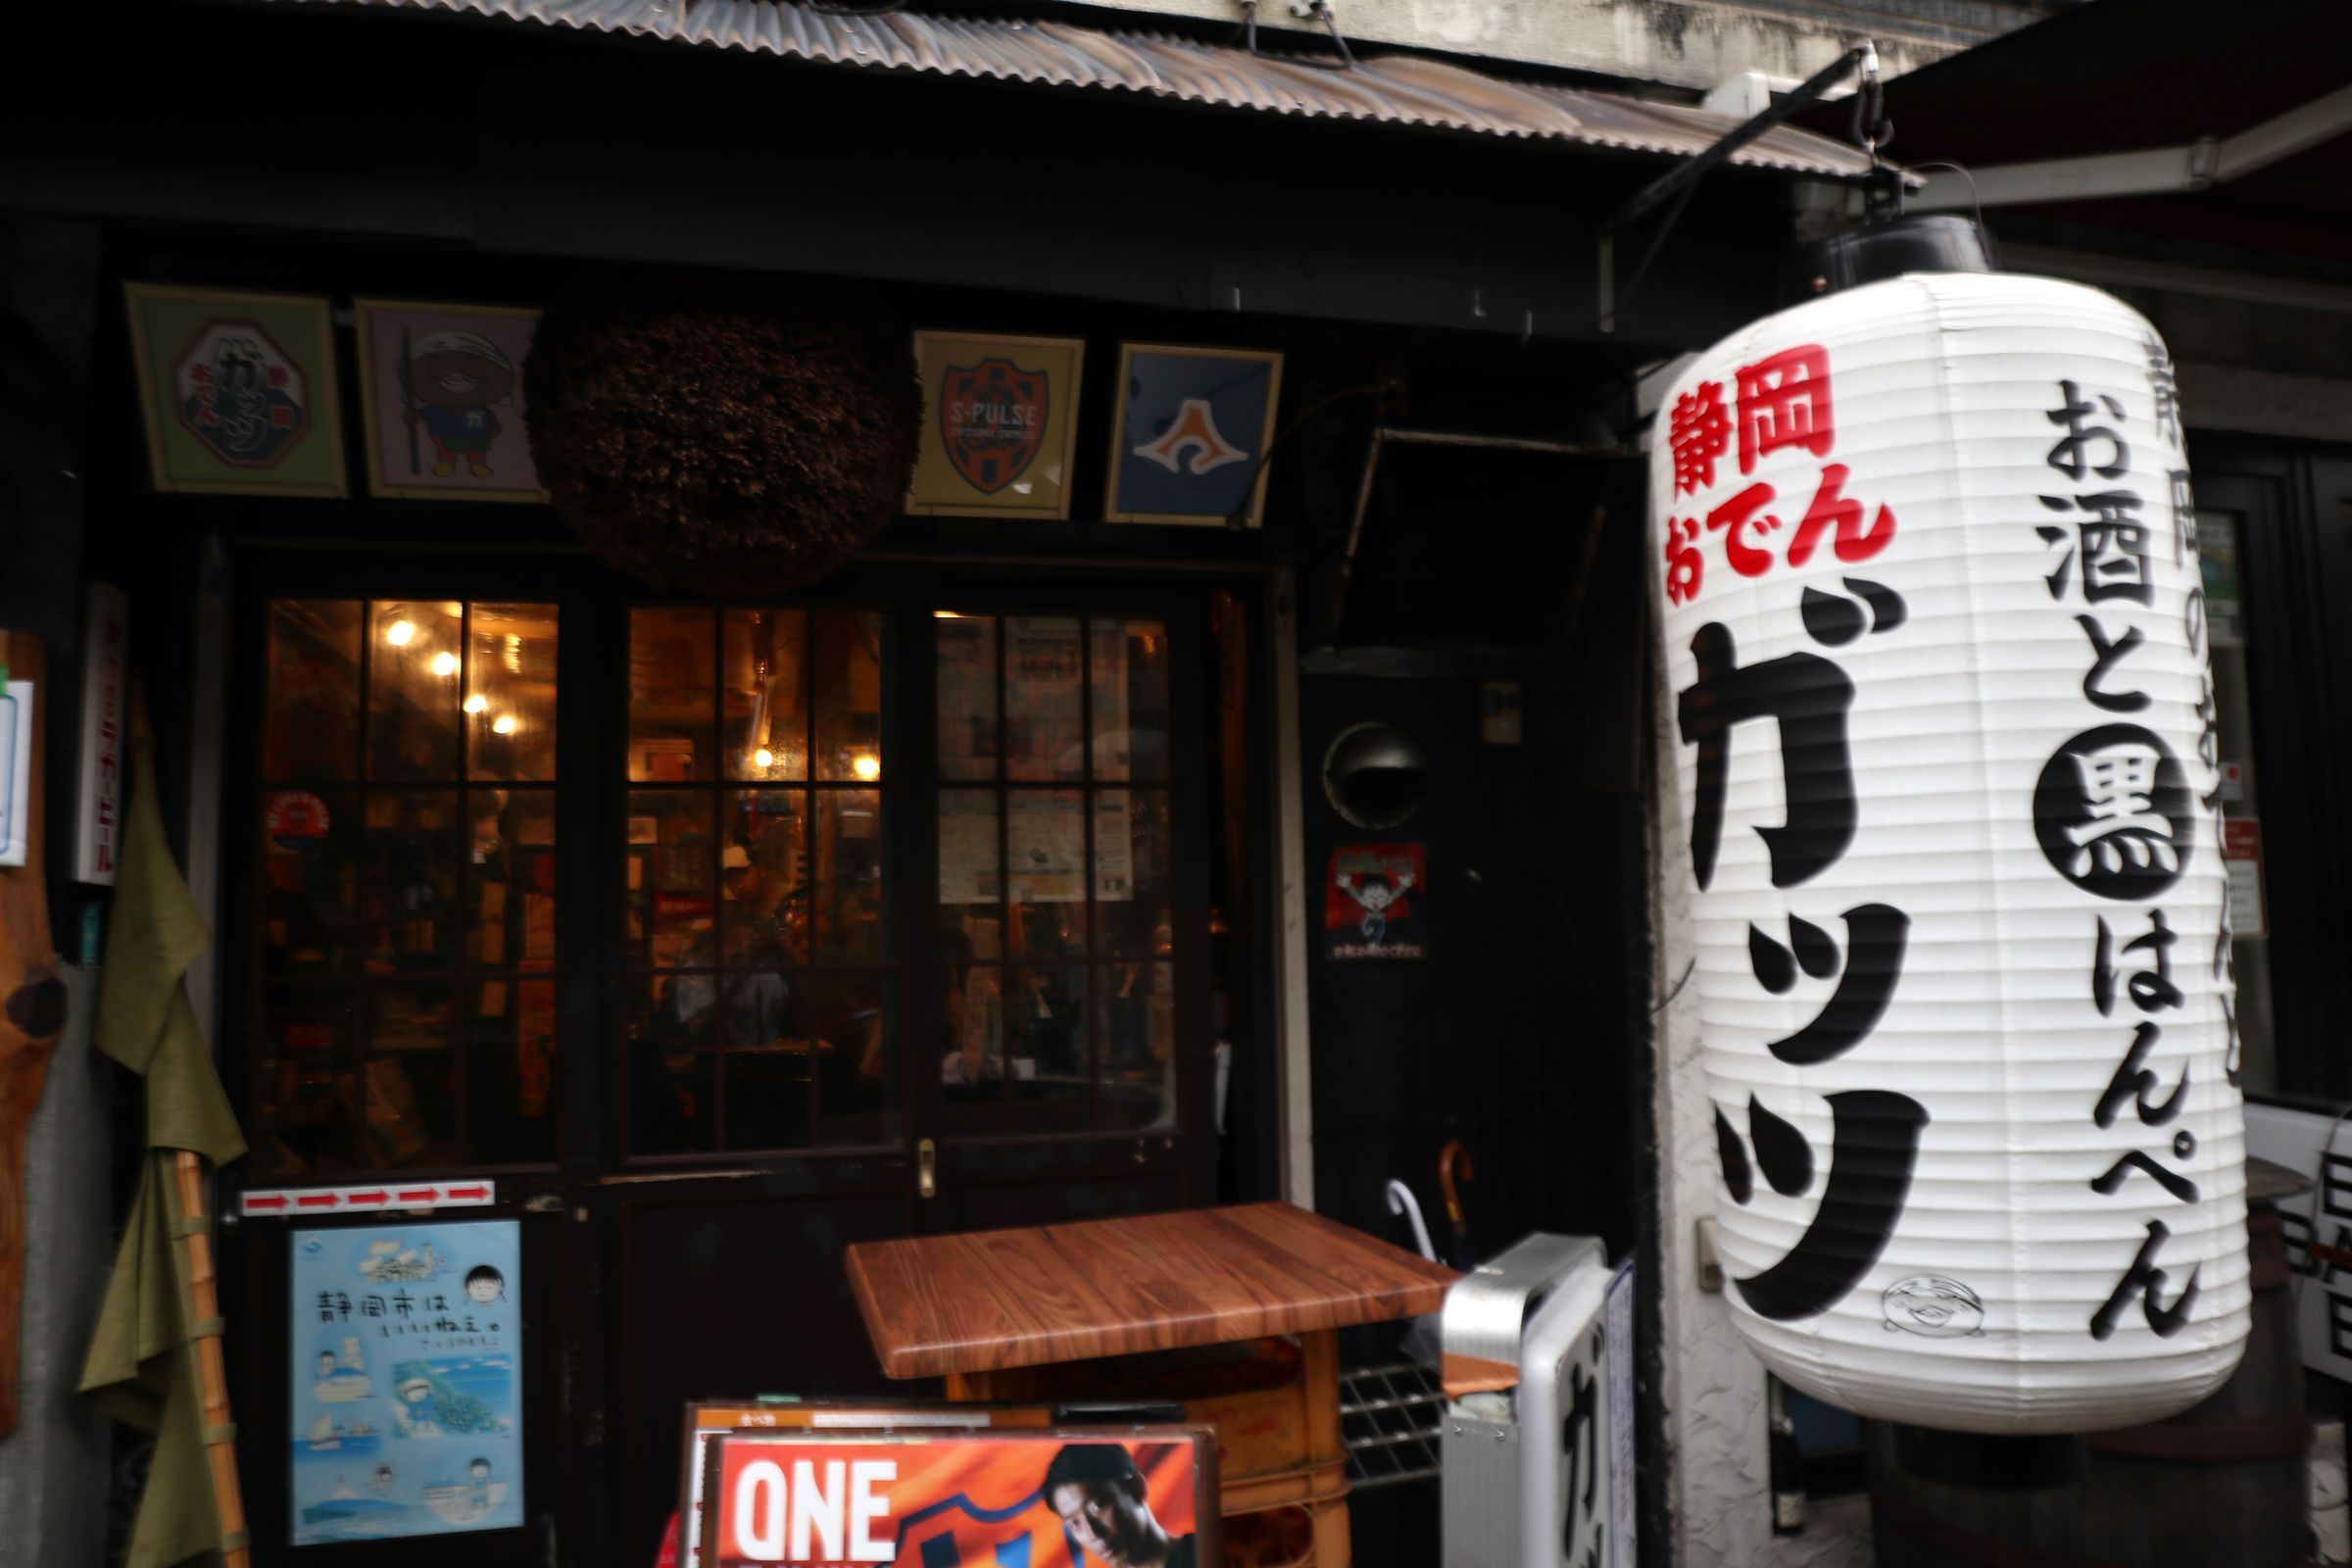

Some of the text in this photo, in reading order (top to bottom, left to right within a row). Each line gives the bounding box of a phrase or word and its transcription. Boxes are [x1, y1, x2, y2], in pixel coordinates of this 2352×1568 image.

[950, 402, 1038, 426] S-PULSE
[1668, 344, 1835, 502] 静岡
[1665, 464, 1896, 608] おでん
[2034, 380, 2199, 1343] お酒と黒はんぺん
[1678, 576, 1931, 1320] ガッツ
[316, 1289, 449, 1323] 静岡市は
[734, 1459, 898, 1561] ONE
